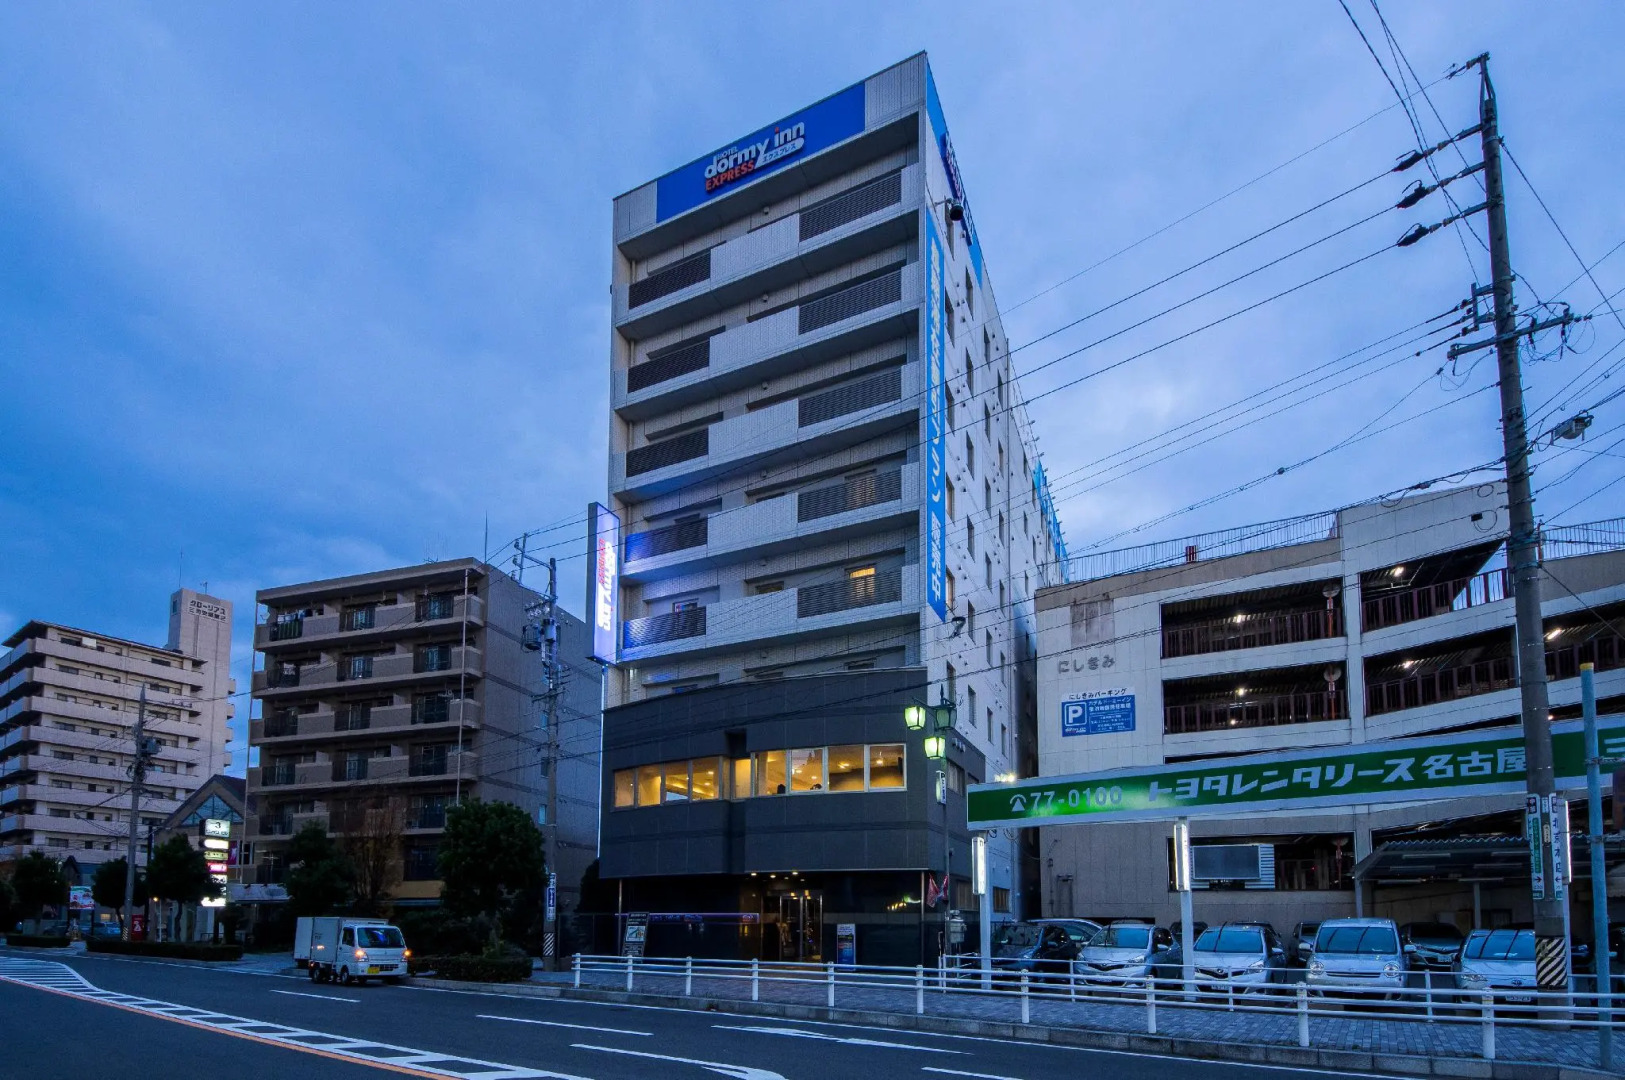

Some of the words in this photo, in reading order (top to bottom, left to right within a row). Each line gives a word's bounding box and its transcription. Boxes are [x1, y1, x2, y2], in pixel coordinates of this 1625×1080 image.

[704, 138, 770, 178] dormy
[774, 121, 805, 148] inn
[705, 159, 756, 191] EXPRESS
[1058, 654, 1115, 674] にしきみ
[1069, 688, 1127, 700] にしきみパーキング
[1068, 705, 1083, 724] P
[1149, 747, 1527, 801] トヨタレンタリース名古屋
[1030, 785, 1123, 810] 77-0100
